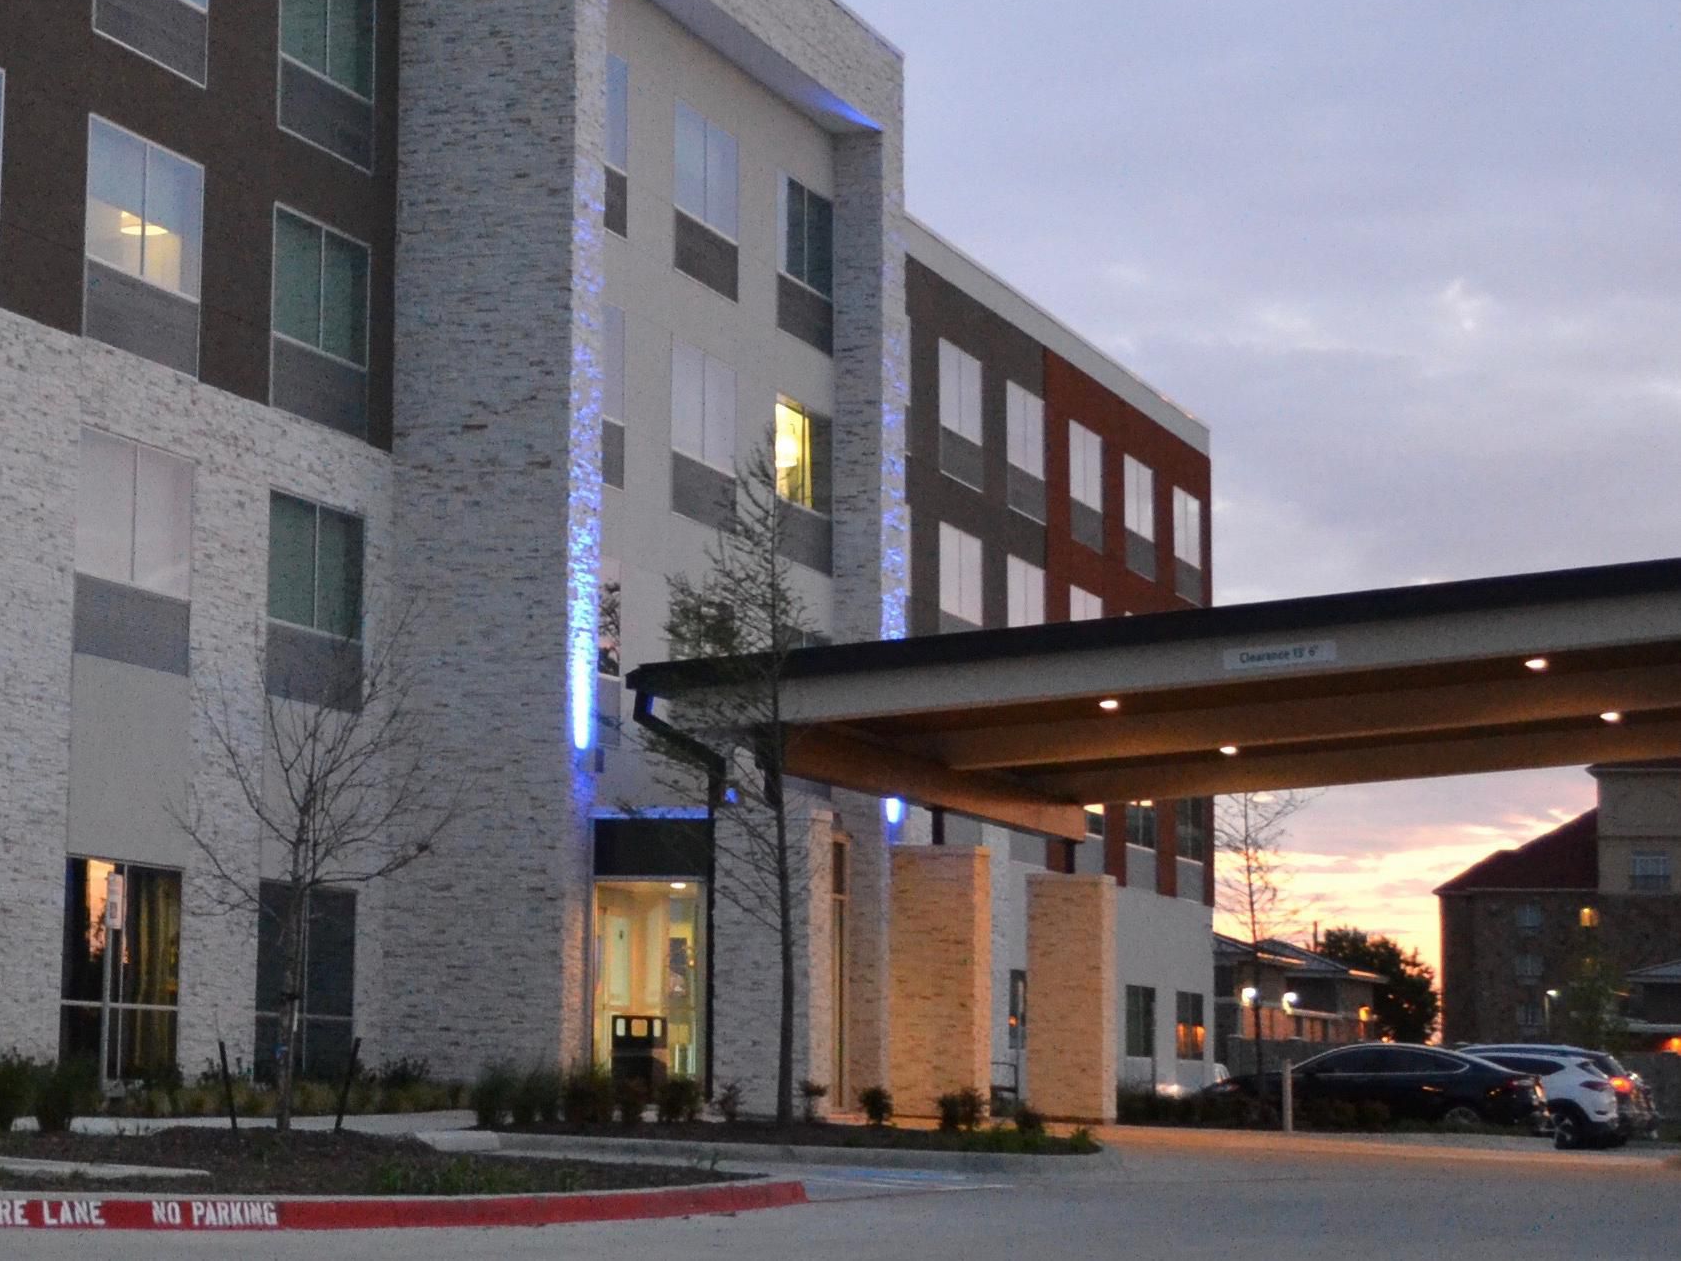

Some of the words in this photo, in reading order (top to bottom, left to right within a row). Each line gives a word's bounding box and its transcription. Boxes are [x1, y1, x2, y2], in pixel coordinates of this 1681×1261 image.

[1239, 651, 1291, 664] Clearance
[43, 1200, 106, 1226] LANE
[152, 1200, 182, 1225] NO
[192, 1200, 278, 1226] PARKING
